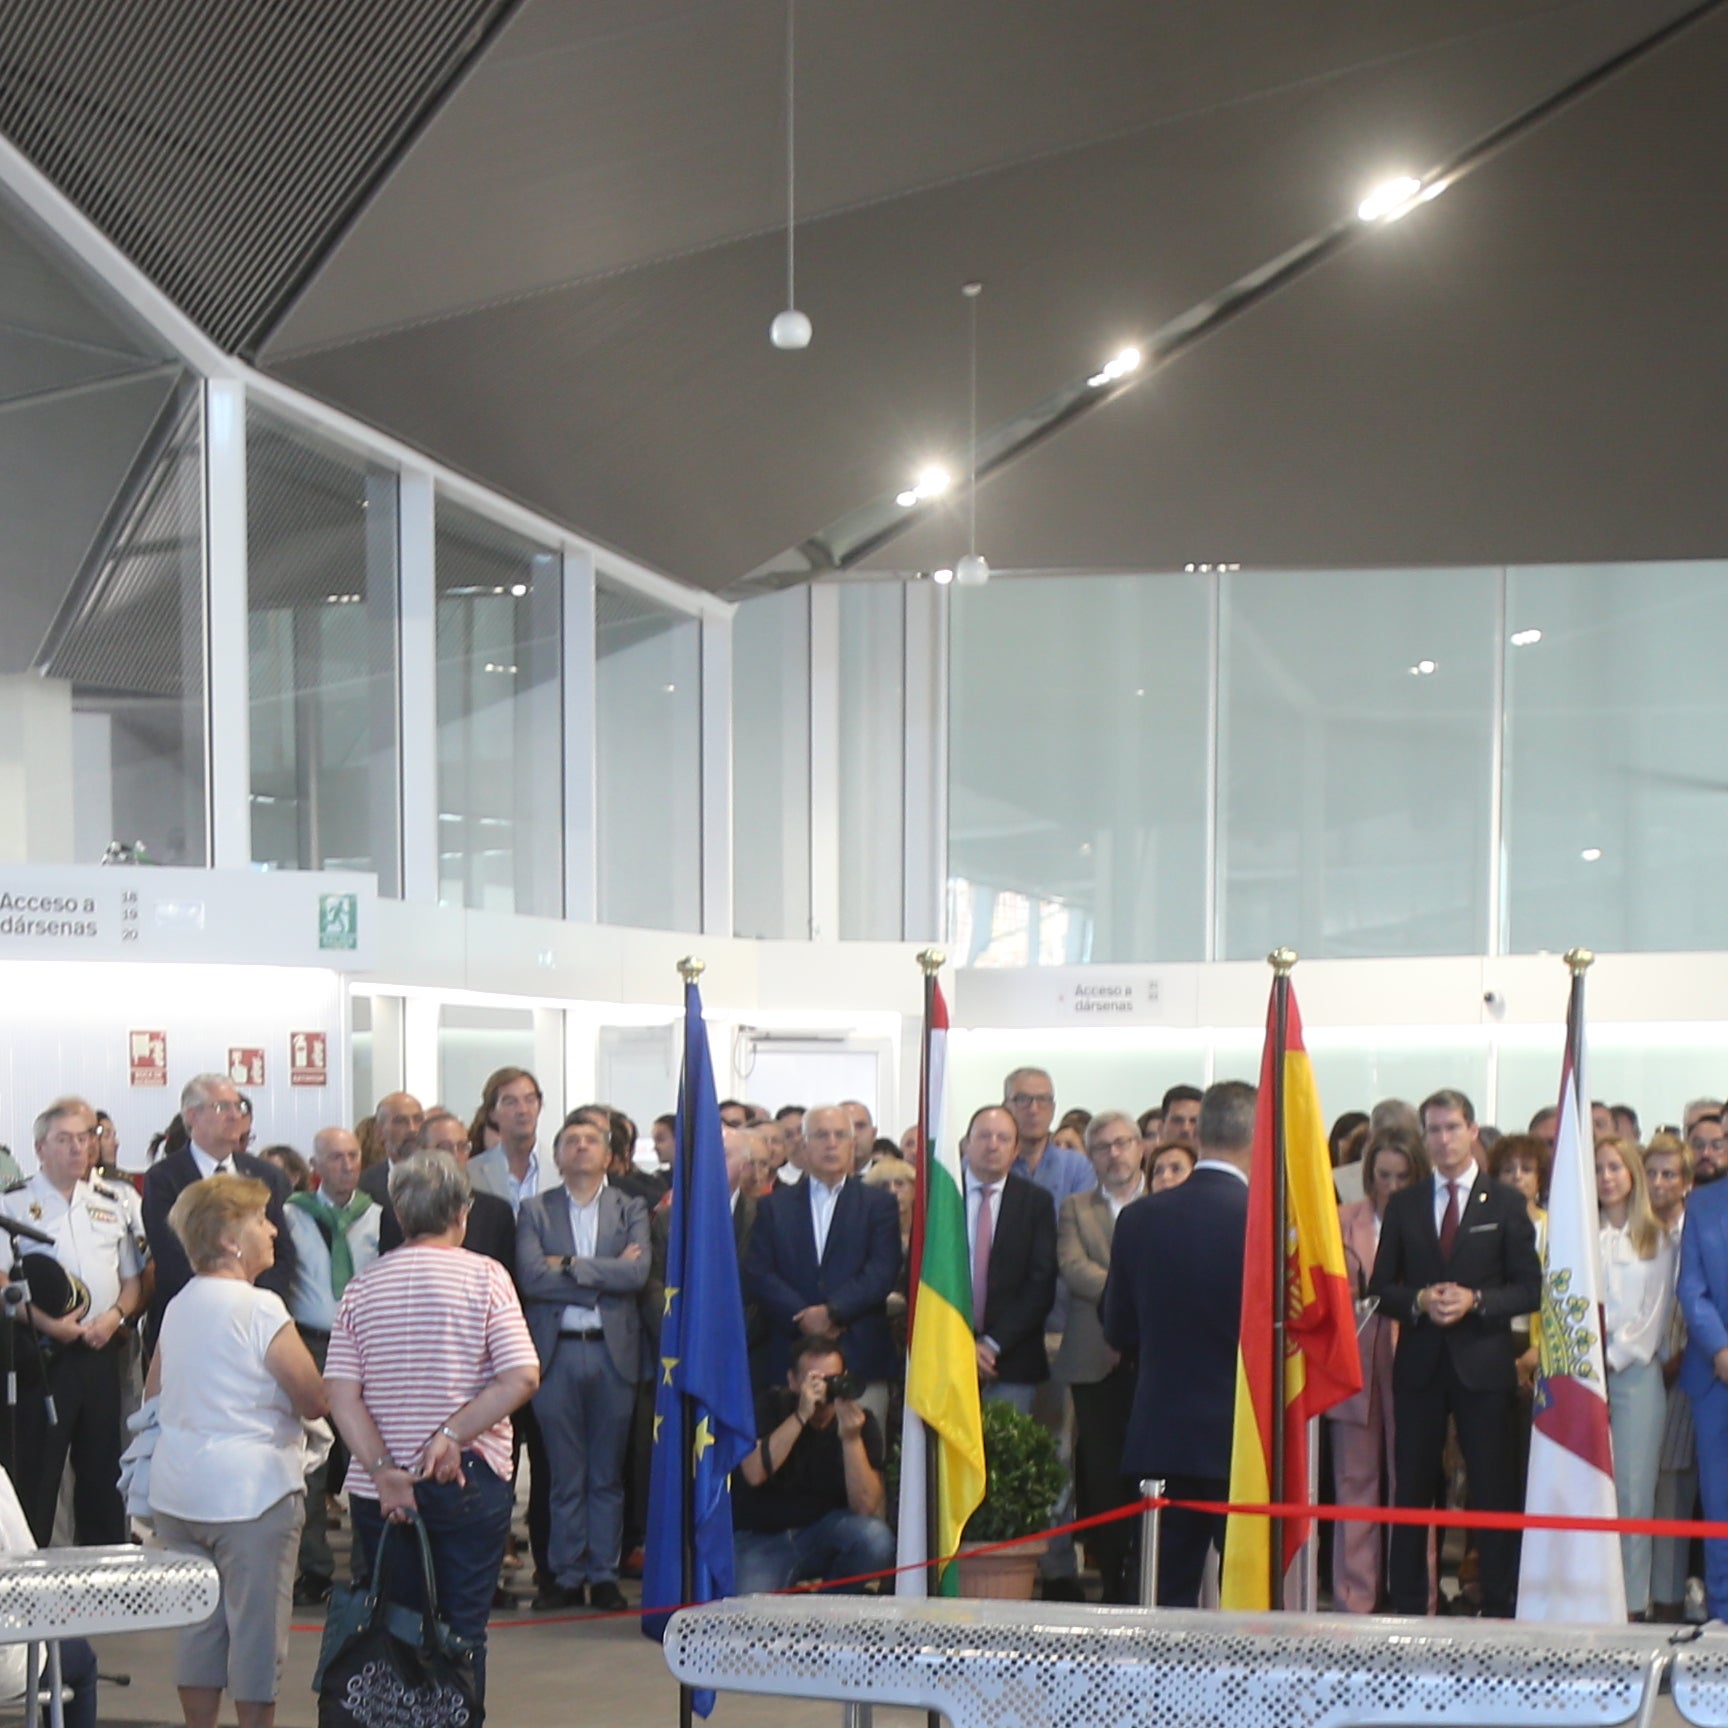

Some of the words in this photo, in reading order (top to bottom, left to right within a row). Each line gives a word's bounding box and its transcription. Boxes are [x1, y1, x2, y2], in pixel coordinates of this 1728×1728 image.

[0, 892, 78, 913] Acceso
[82, 897, 95, 913] a
[0, 915, 98, 936] dársenas
[1075, 983, 1122, 997] Acceso
[1075, 998, 1134, 1012] dársenas
